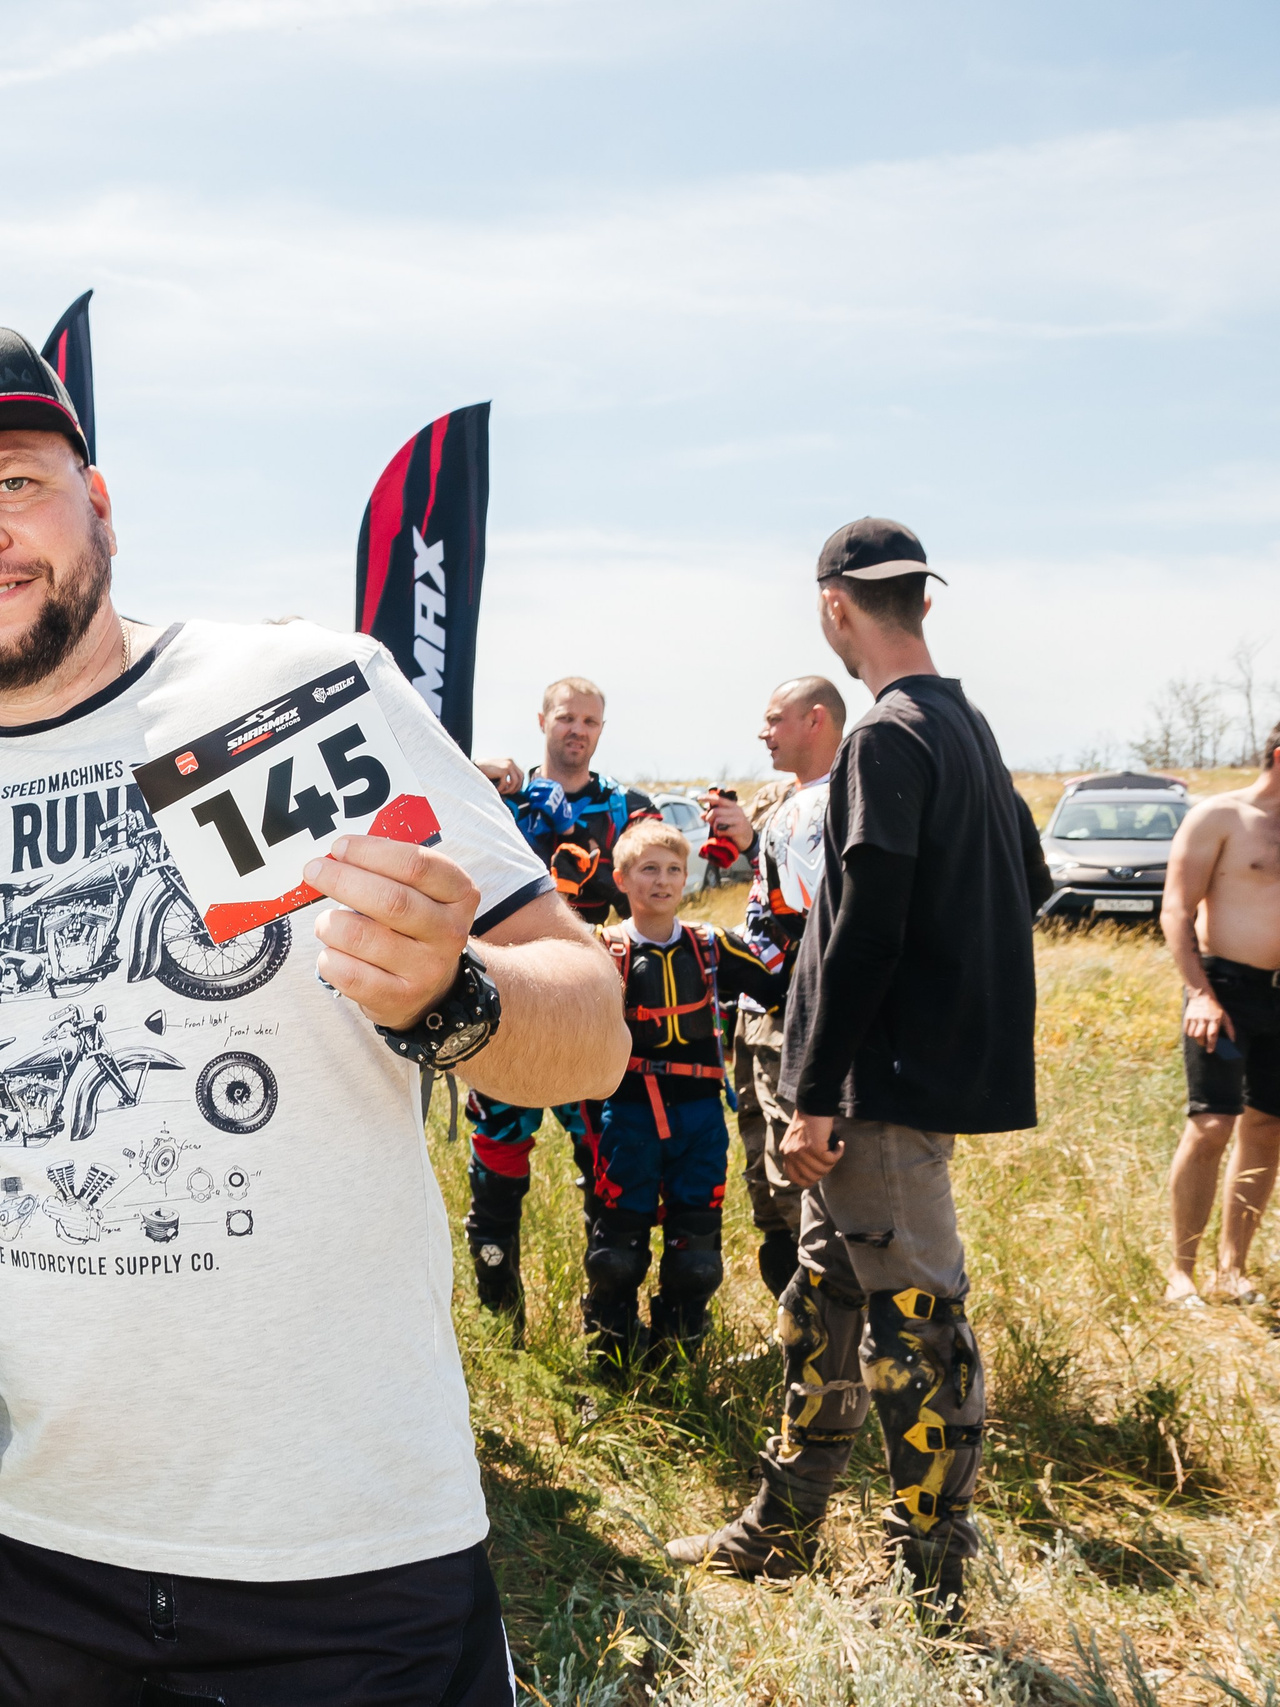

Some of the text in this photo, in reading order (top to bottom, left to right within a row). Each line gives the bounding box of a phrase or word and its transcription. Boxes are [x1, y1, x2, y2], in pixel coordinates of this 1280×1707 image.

[227, 706, 299, 752] SHARMAX
[275, 716, 301, 734] MOTORS
[0, 760, 124, 800] SPEED MACHINES
[191, 723, 391, 878] 145
[184, 1010, 229, 1029] Front light
[229, 1022, 280, 1038] Front wheel
[10, 1248, 108, 1276] MOTORCYCLE
[114, 1254, 183, 1276] SUPPLY
[190, 1251, 220, 1272] CO.
